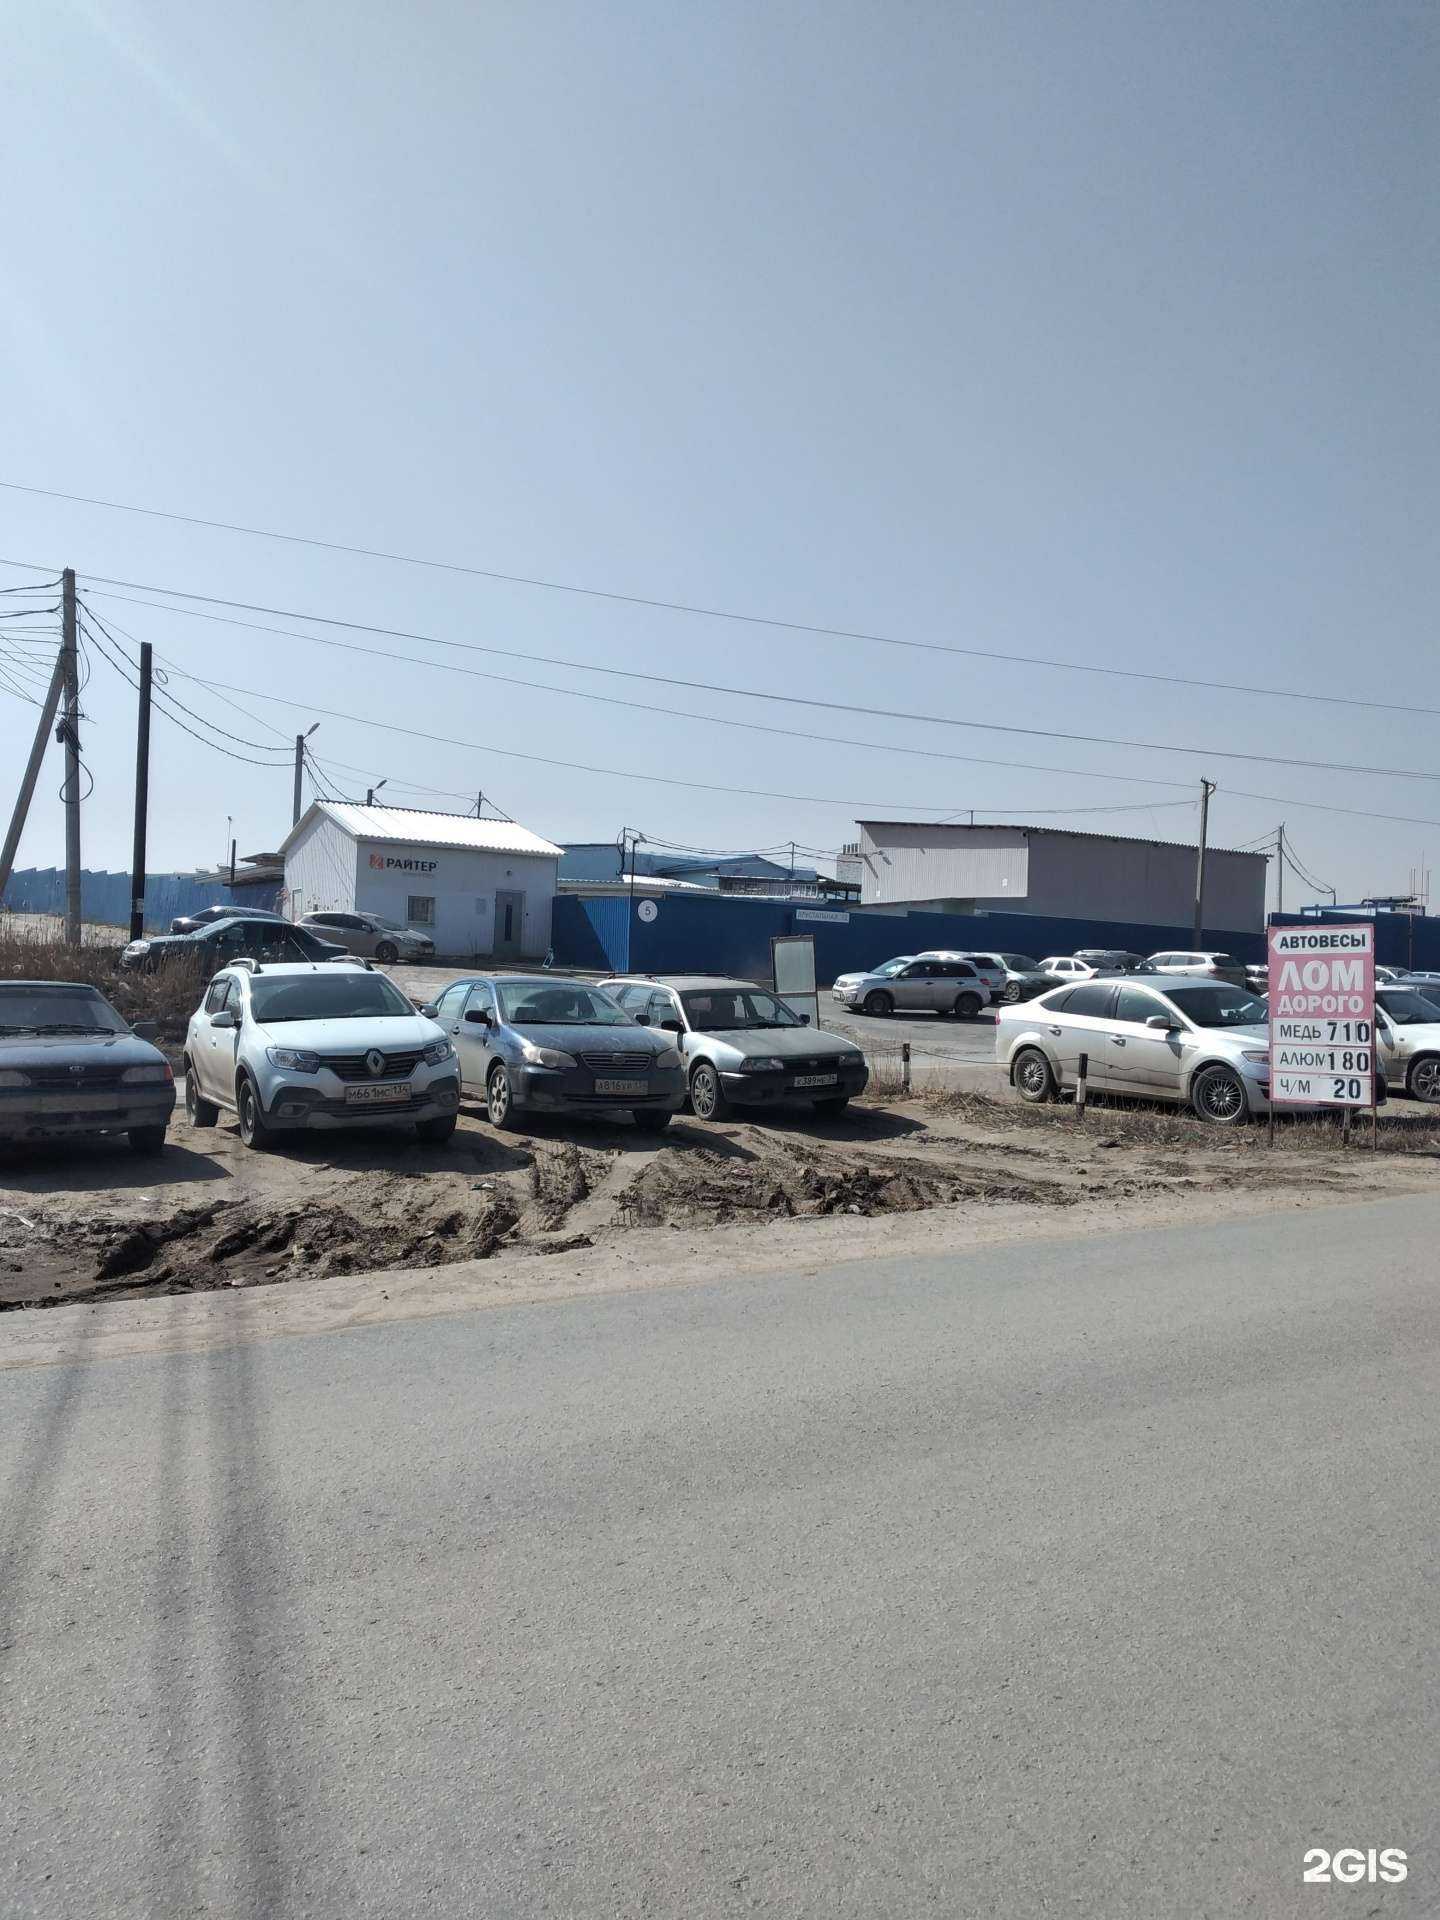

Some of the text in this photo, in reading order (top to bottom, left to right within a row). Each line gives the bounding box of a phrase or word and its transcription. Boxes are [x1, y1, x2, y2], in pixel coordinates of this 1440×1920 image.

[386, 857, 437, 872] РАЙТЕР
[645, 905, 651, 915] 5
[1279, 933, 1366, 949] АВТОВЕСЫ
[1277, 959, 1364, 992] ЛОМ
[1277, 995, 1364, 1015] ДОРОГО
[1280, 1022, 1370, 1043] МЕДЬ 710
[1328, 1052, 1369, 1072] 180
[1280, 1079, 1361, 1099] Ч/М 20
